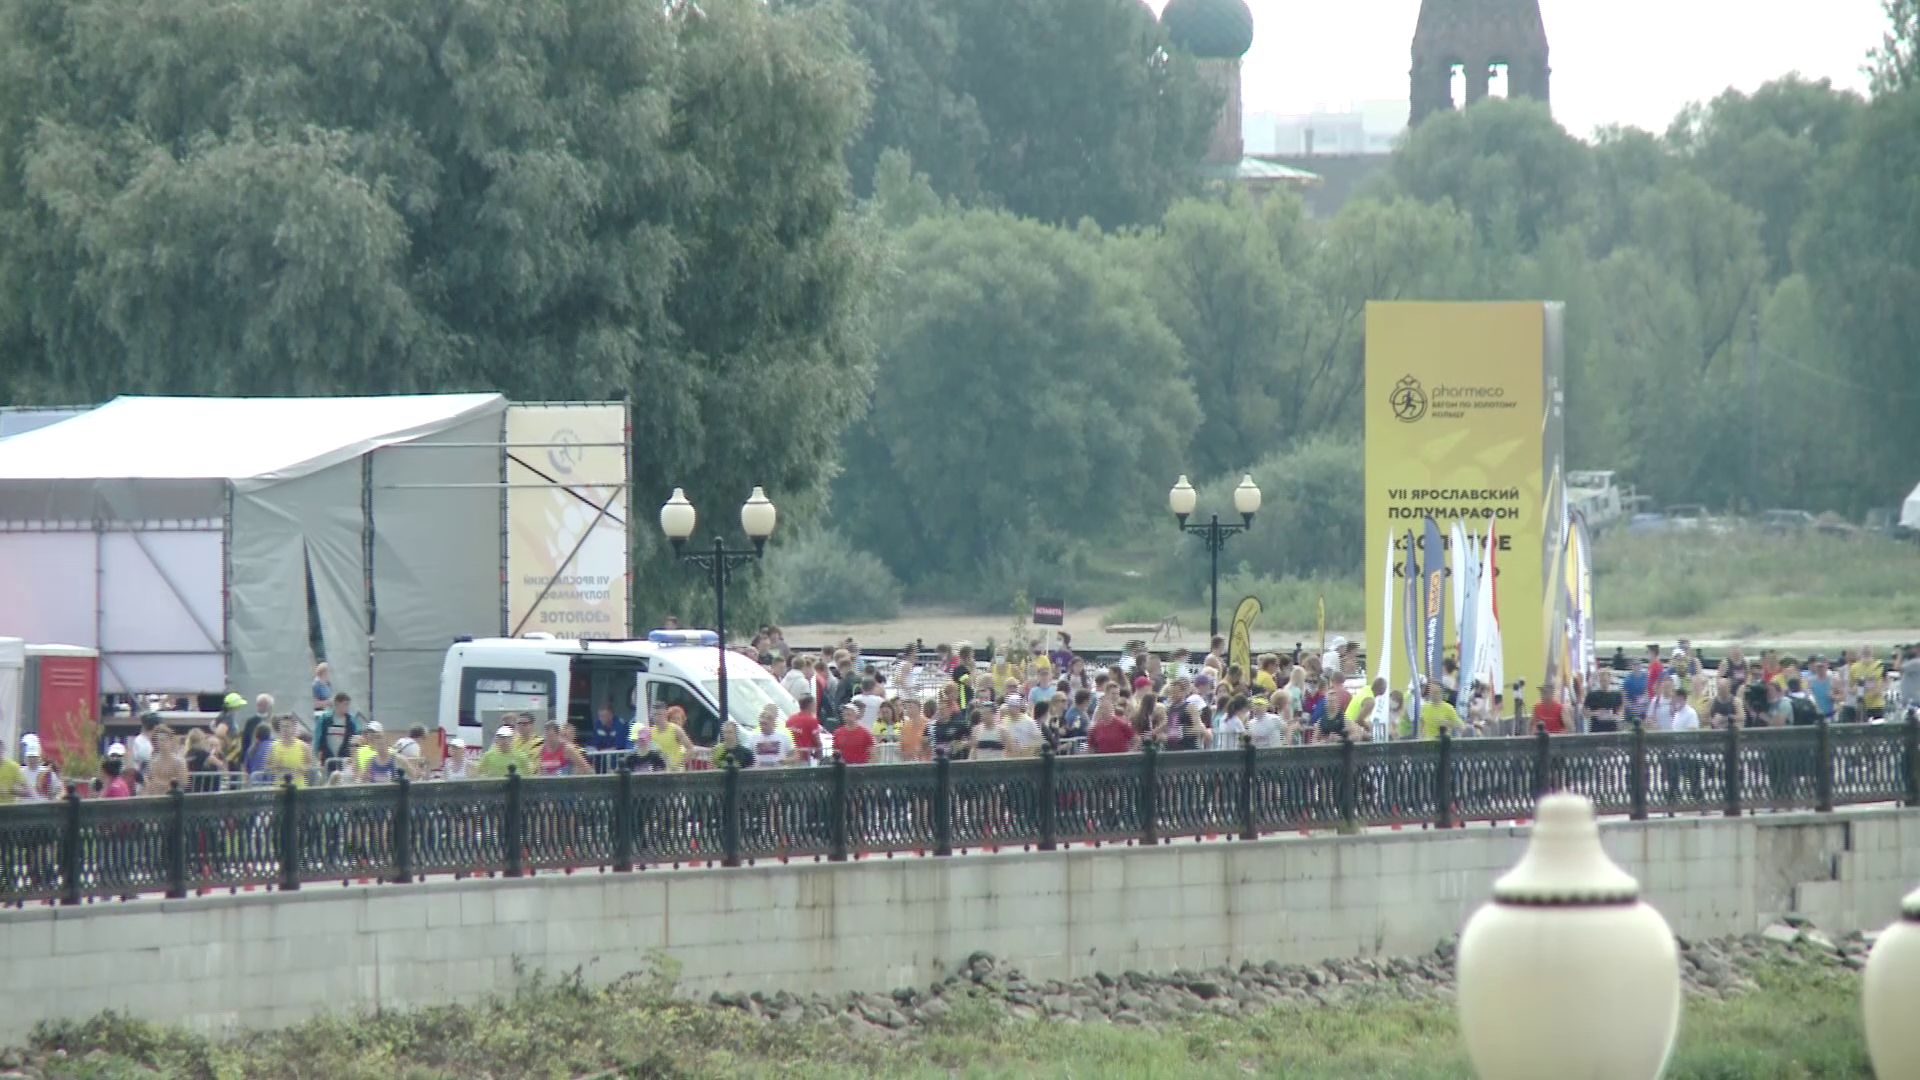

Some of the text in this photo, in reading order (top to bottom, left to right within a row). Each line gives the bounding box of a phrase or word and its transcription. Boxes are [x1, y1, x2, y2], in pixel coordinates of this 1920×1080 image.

[1431, 383, 1504, 400] pharmeco
[1388, 487, 1520, 500] VII ЯРОСЛАВСКИЙ
[1388, 507, 1519, 520] ПОЛУМАРАФОН
